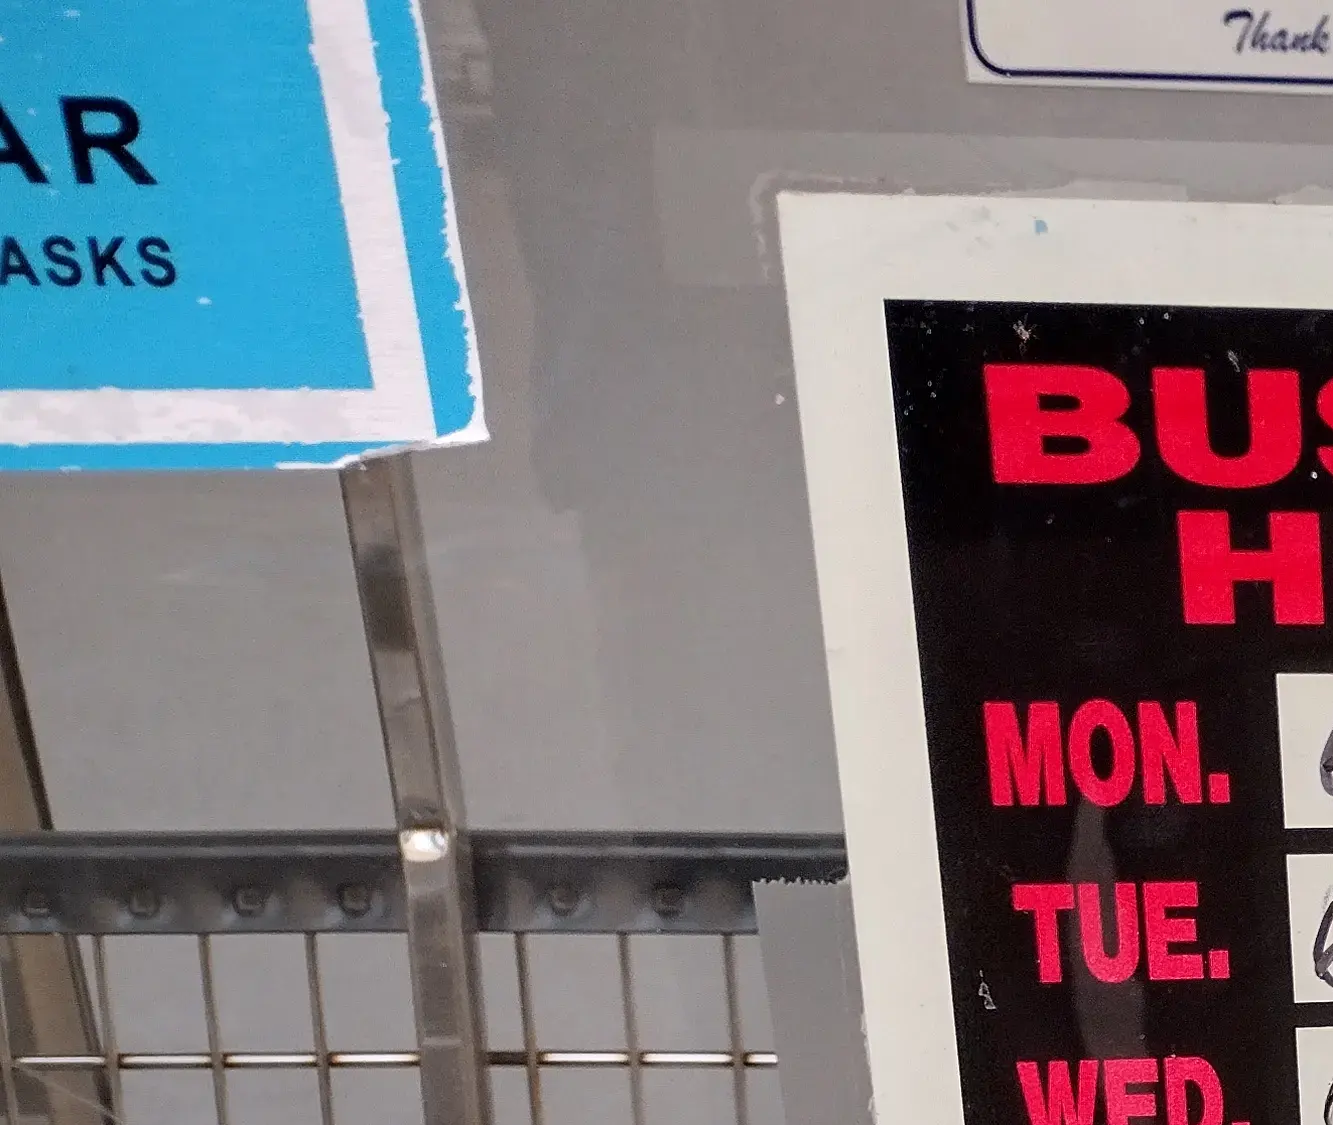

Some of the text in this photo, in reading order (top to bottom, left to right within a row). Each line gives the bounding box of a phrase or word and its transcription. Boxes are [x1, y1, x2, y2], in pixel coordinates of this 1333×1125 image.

[1223, 10, 1330, 54] Thank
[0, 235, 176, 287] ASKS
[983, 700, 1231, 807] MON.
[1012, 881, 1231, 983] TUE.
